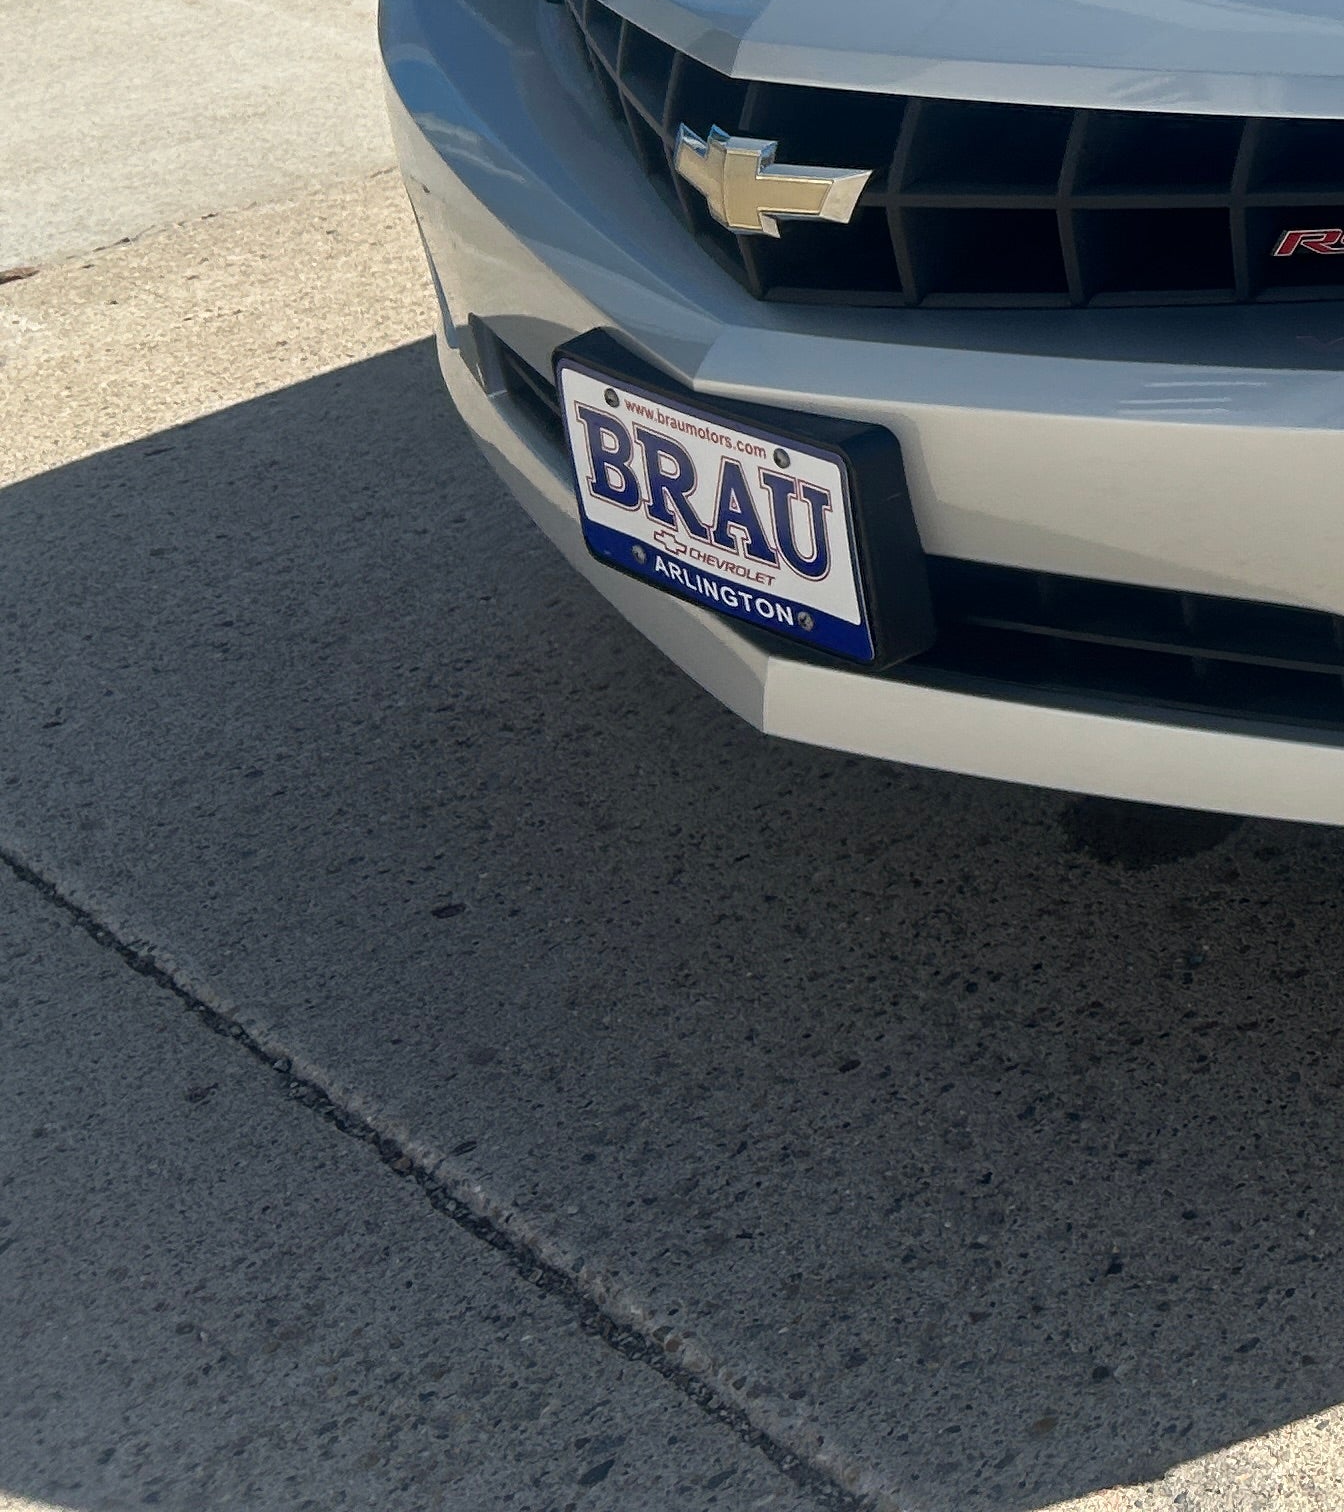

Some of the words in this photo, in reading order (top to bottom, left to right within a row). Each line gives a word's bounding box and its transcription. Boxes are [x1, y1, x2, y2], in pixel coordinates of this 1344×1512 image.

[623, 398, 767, 459] www.braumotors.com
[573, 400, 833, 581] BRAU
[654, 554, 794, 626] ARLINGTON
[688, 548, 776, 587] CHEVROLET
